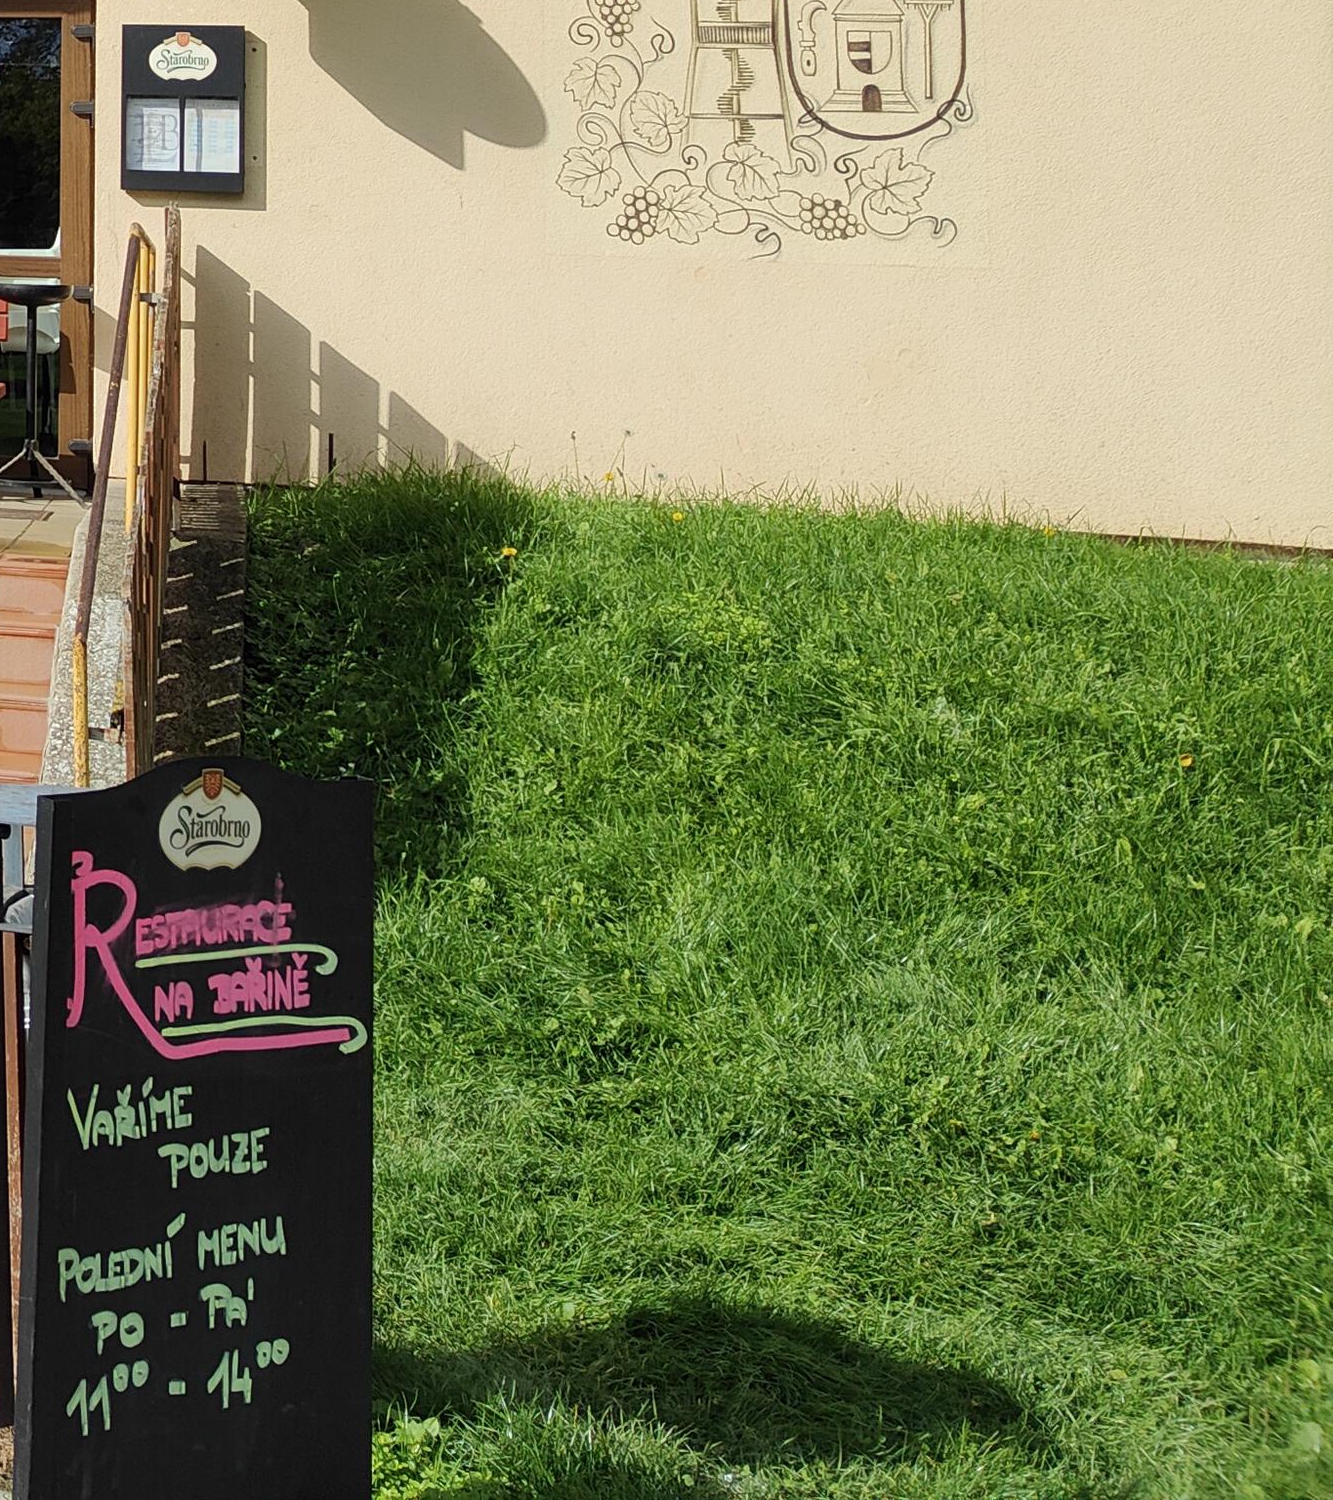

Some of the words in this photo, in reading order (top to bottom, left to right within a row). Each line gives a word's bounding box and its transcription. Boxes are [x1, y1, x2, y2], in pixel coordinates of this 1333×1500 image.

[156, 49, 209, 73] Starobrno
[169, 805, 251, 857] Starobrno
[66, 851, 295, 1045] RESTAURACE
[154, 981, 194, 1023] NA
[67, 1076, 193, 1150] VAŘÍME
[157, 1127, 270, 1188] POUZE
[58, 1212, 186, 1303] POLEDNÍ
[197, 1215, 287, 1270] MENU
[90, 1310, 144, 1355] PO
